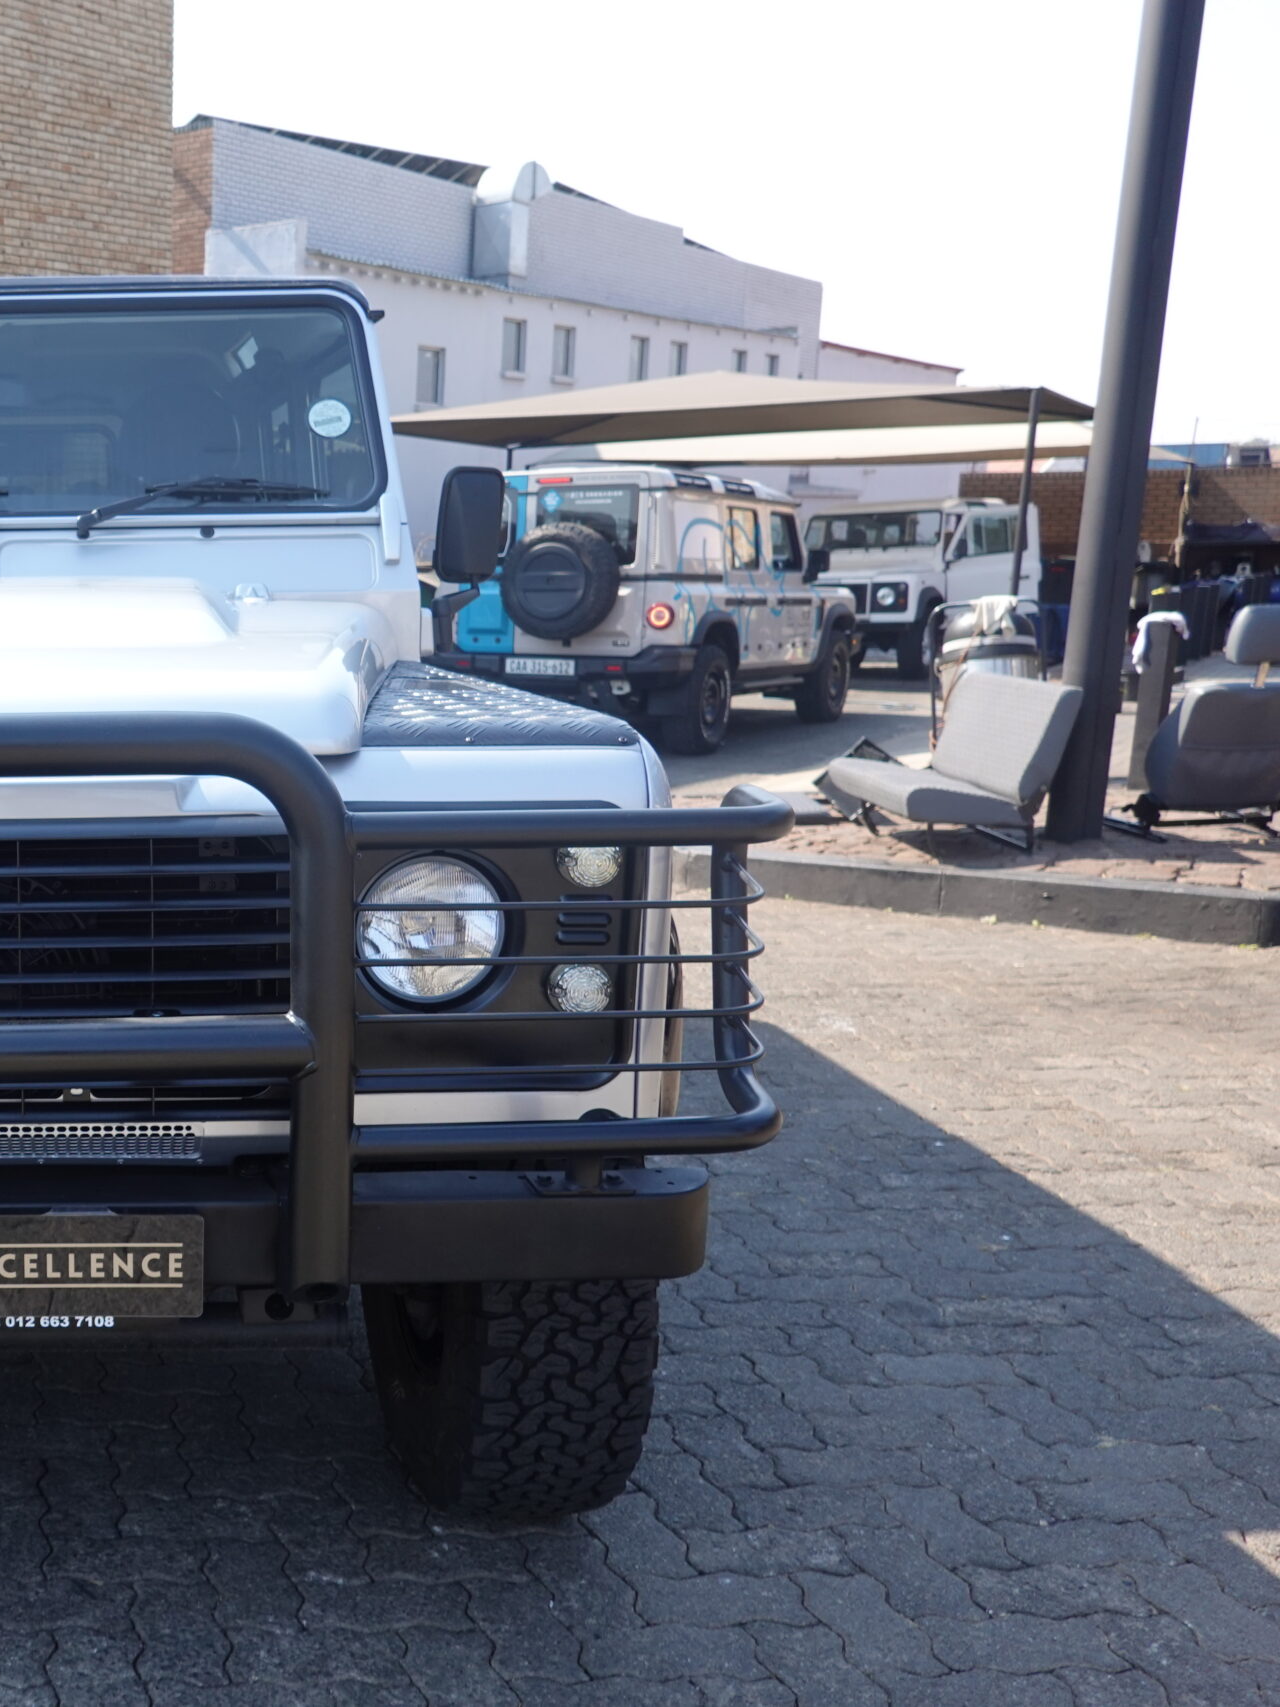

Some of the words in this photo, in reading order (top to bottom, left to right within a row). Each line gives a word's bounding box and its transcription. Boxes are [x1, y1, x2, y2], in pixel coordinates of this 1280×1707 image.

[5, 1316, 35, 1328] 012
[40, 1316, 69, 1328] 663
[75, 1316, 114, 1328] 7108
